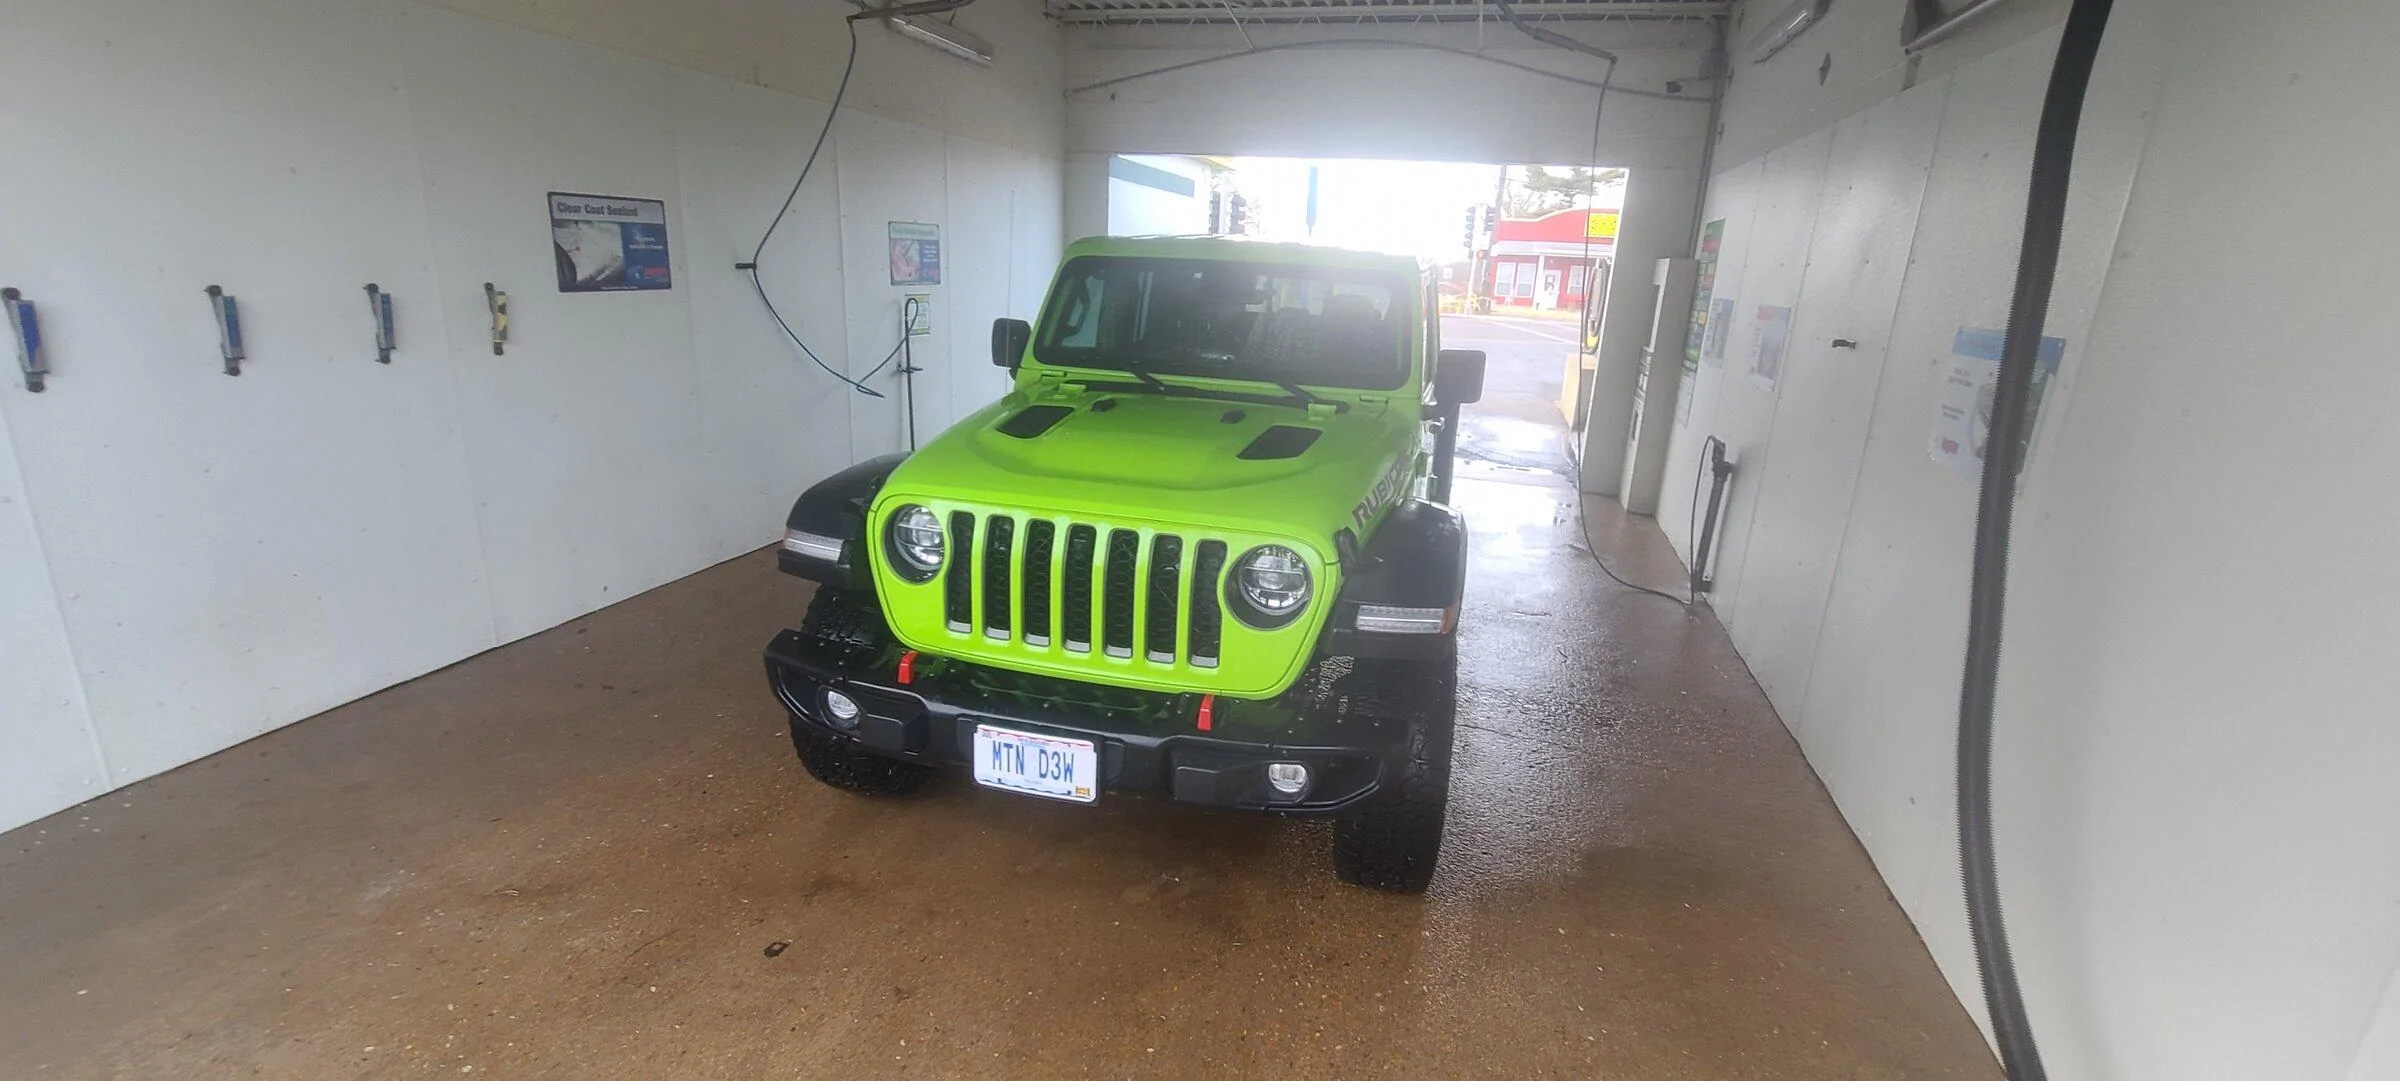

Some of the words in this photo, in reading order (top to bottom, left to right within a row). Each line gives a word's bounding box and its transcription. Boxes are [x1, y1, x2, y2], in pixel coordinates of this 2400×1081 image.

[584, 203, 605, 215] Coat
[1351, 452, 1414, 530] RUBIC
[992, 740, 1025, 775] MTN
[1038, 748, 1075, 783] D3W
